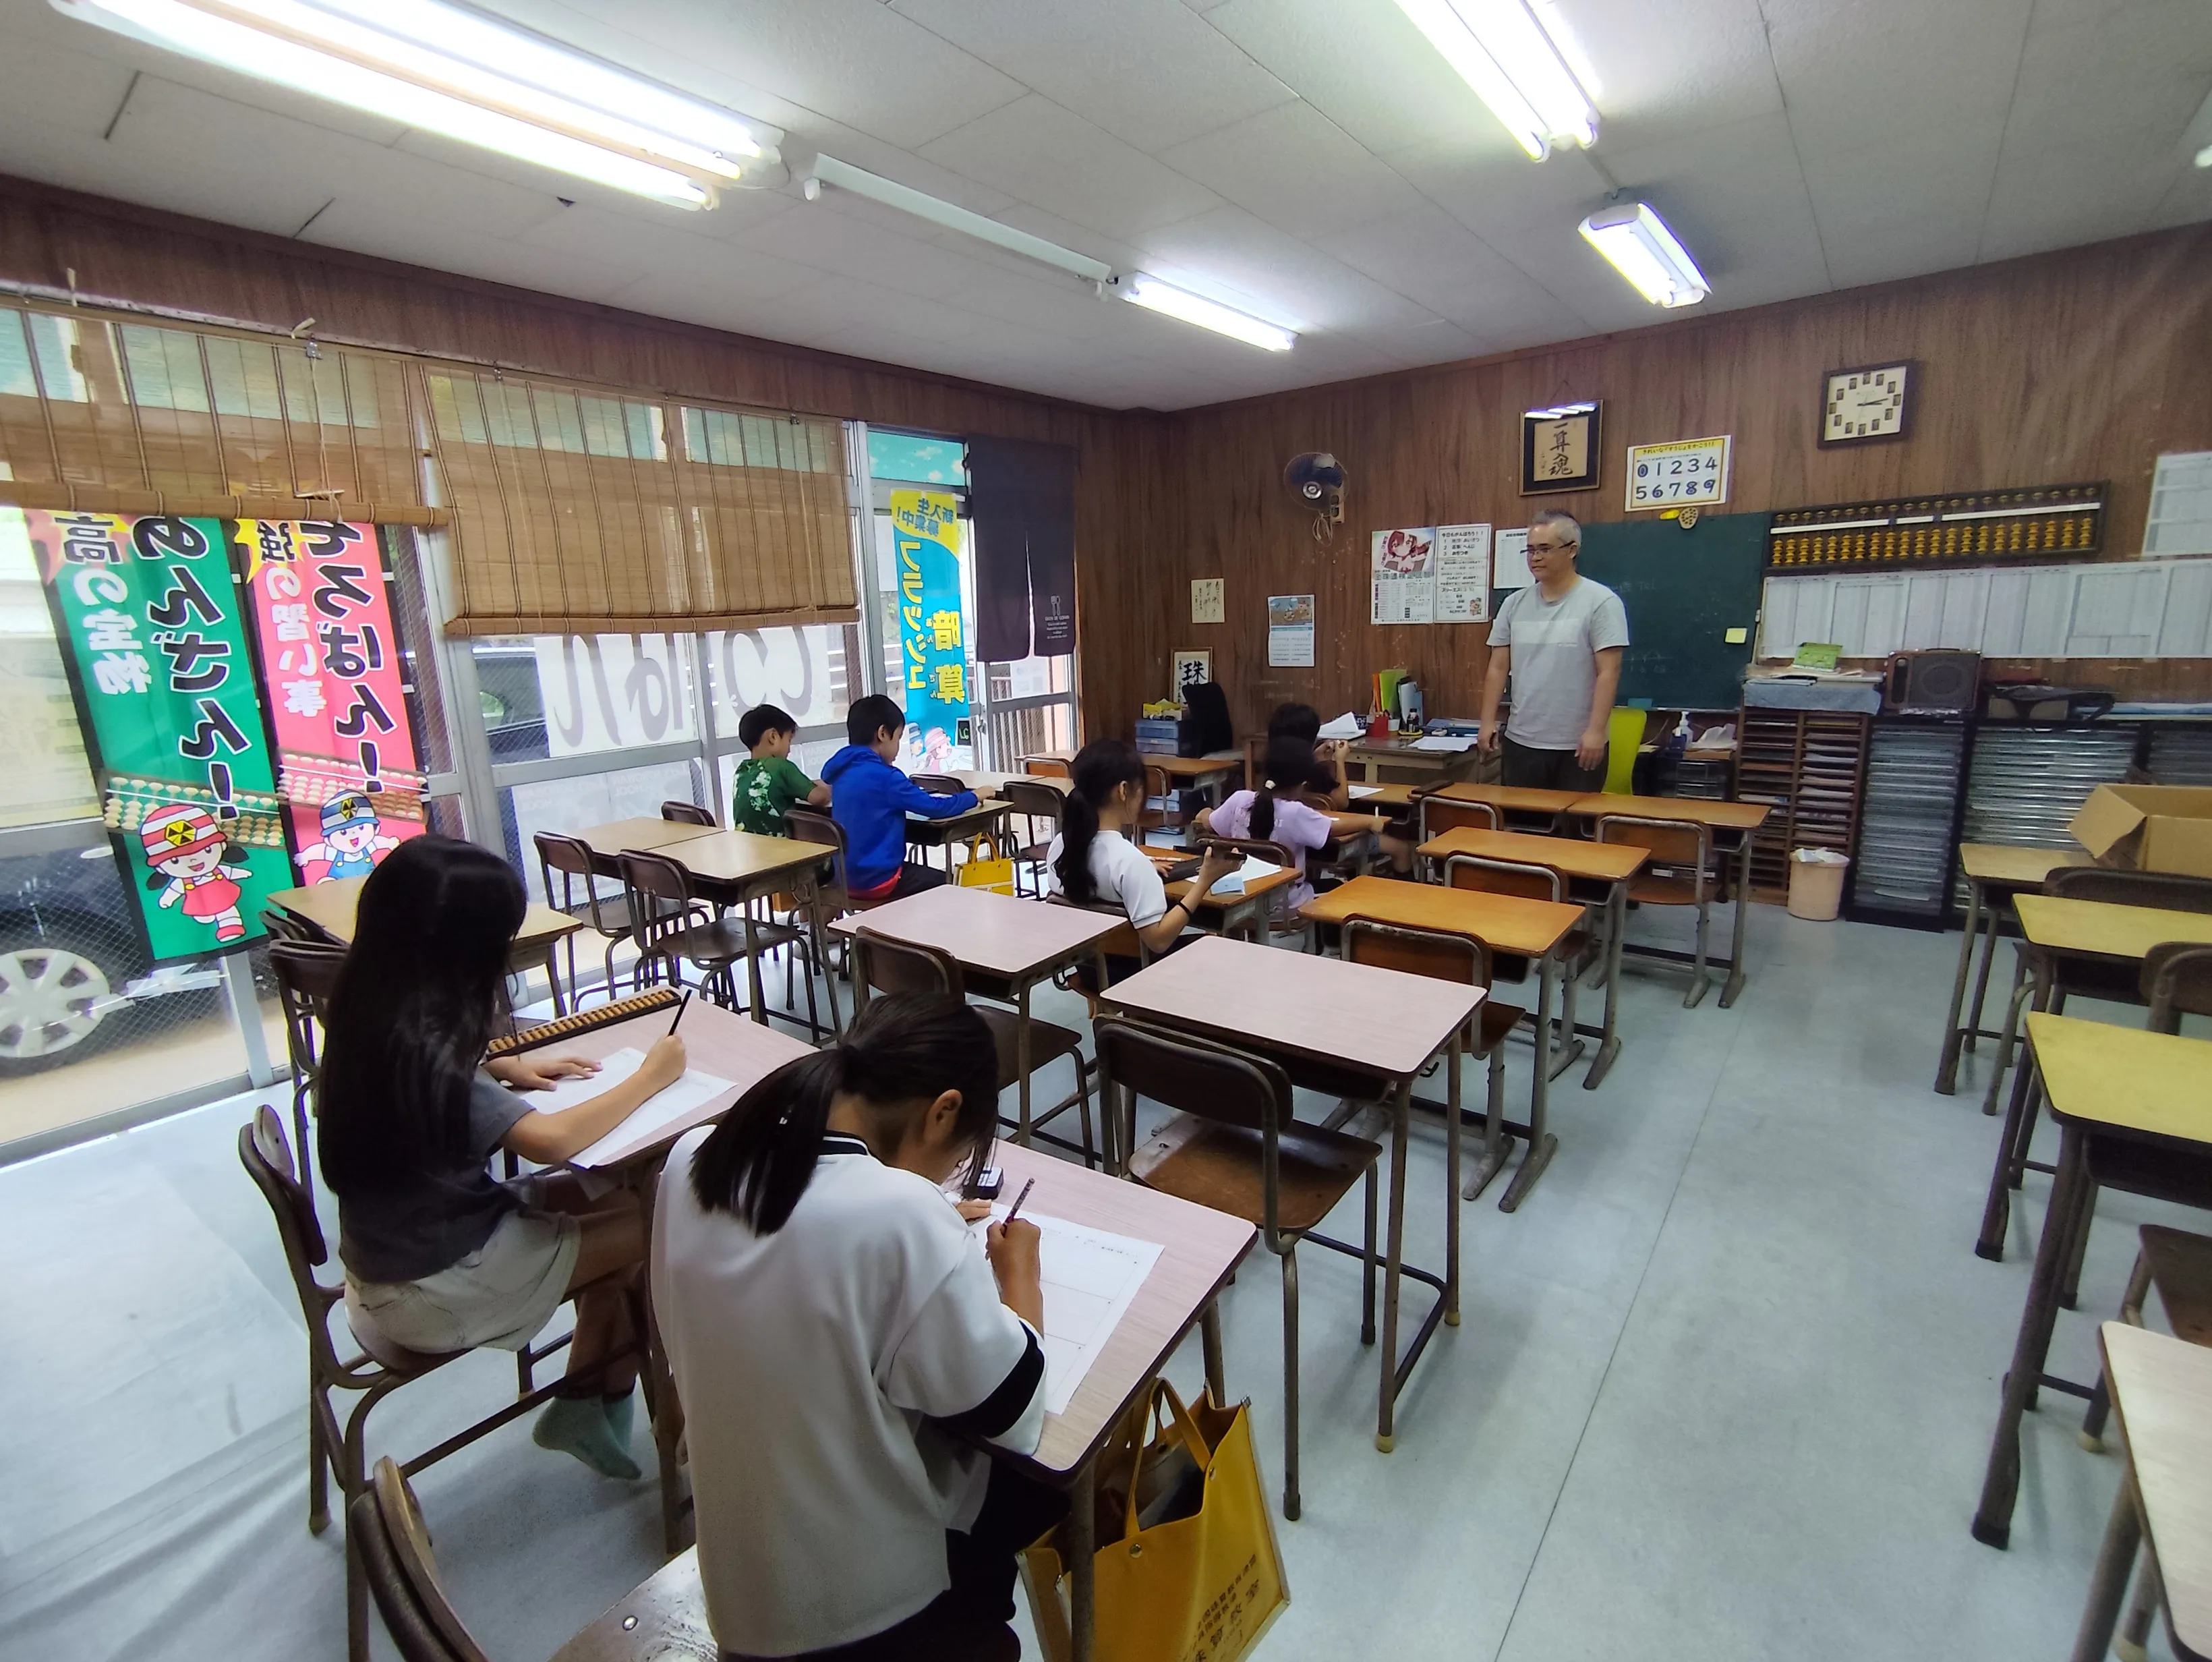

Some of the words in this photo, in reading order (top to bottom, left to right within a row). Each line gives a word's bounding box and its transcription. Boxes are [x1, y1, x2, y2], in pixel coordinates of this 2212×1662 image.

[1637, 464, 1648, 478] 0
[1657, 462, 1661, 476] 1
[1670, 460, 1682, 474] 2
[1687, 459, 1699, 473] 3
[1705, 457, 1718, 470] 4
[1635, 486, 1648, 500] 5
[1652, 484, 1664, 498] 6
[1669, 482, 1681, 497] 7
[1686, 481, 1697, 495] 8
[1704, 479, 1716, 493] 9
